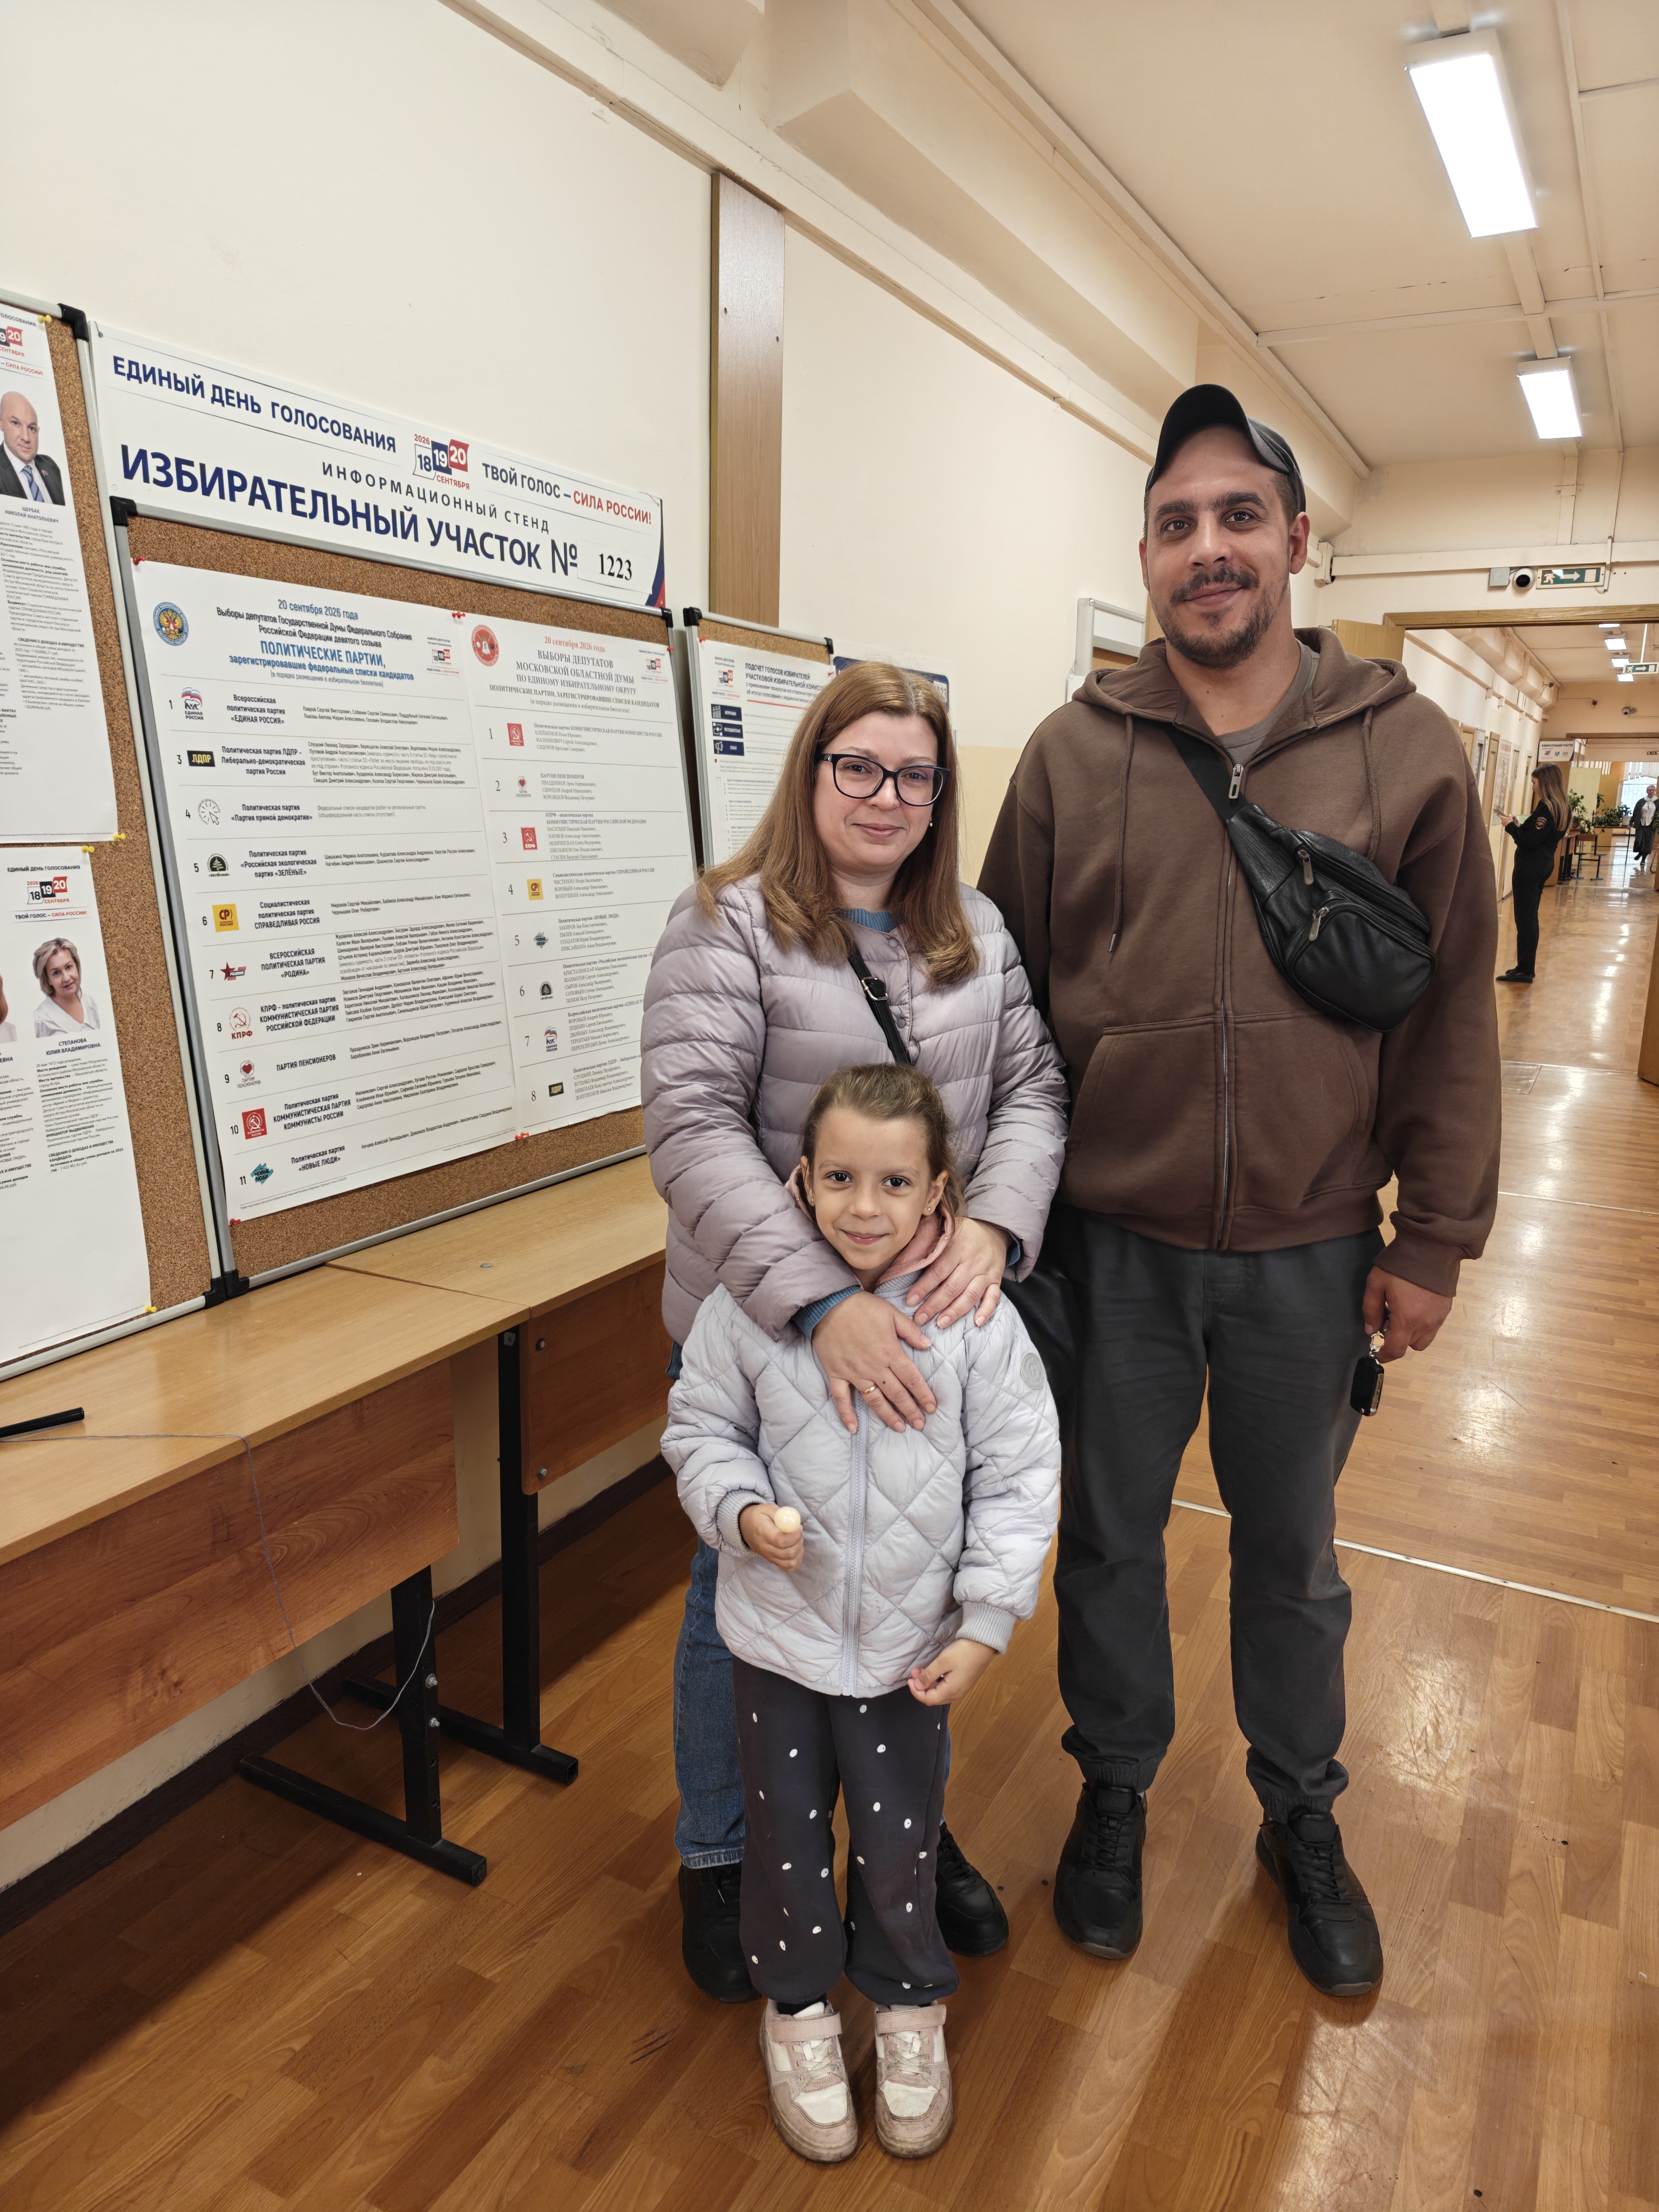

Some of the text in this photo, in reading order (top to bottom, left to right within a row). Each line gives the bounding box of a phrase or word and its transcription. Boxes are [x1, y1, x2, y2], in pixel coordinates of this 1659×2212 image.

[0, 313, 36, 327] ОЛОСОВАНИЯ
[7, 329, 21, 341] 20
[21, 366, 43, 375] РОССИИ!
[113, 355, 396, 453] ЕДИНЫЙ ДЕНЬ ГОЛОСОВАНИЯ
[414, 433, 430, 446] 2026
[417, 445, 467, 473] 18 19 20
[436, 475, 470, 490] СЕНТЯБРЯ
[322, 462, 549, 534] ИНФОРМАЦИОННЫЙ СТЕНД
[482, 462, 652, 525] ТВОЙ ГОЛОС СИЛА РОССИИ!
[5, 509, 59, 523] НИКОЛАЙ АНАТОЛЬЕВИЧ
[120, 443, 632, 581] ИЗБИРАТЕЛЬНЫЙ УЧАСТОК № 1223
[278, 599, 358, 620] 20 сентября 2026 года
[217, 606, 412, 640] Выборы депутатов Государственной Думы Федерального Собрания
[259, 625, 381, 648] Российской Федерации девятого созыва
[544, 636, 551, 644] 20
[552, 637, 578, 649] сентября
[579, 642, 592, 650] 2026
[260, 640, 386, 668] ПОЛИТИЧЕСКИЕ ПАРТИИ,
[537, 650, 613, 669] ВЫБОРЫ ДЕПУТАТОВ
[229, 655, 306, 670] зарегистрировавшие
[308, 663, 353, 675] федеральные
[355, 669, 377, 677] списки
[379, 670, 414, 680] кандидатов
[516, 660, 569, 676] МОСКОВСКОЙ
[570, 667, 613, 682] ОБЛАСТНОЙ
[615, 673, 634, 684] ДУМЫ
[745, 663, 810, 680] ПОДСЧЕТ ГОЛОСОВ ИЗБИРАТЕЛЕЙ
[516, 674, 636, 695] ПО ЕДИНОМУ ИЗБИРАТЕЛЬНОМУ ОКРУГУ
[745, 672, 806, 688] УЧАСТКОВОЙ ИЗБИРАТЕЛЬНОЙ
[233, 694, 276, 703] Всероссийская
[490, 684, 532, 694] ПОЛИТИЧЕСКИЕ
[534, 689, 556, 697] ПАРТИИ,
[557, 691, 612, 703] ЗАРЕГИСТРИРОВАВШИЕ
[631, 699, 659, 708] КАНДИДАТОВ
[169, 700, 172, 709] 1
[177, 755, 181, 764] 3
[192, 754, 211, 763] ЛДПР
[221, 757, 305, 765] Либерально-демократическая
[495, 780, 501, 791] 2
[186, 810, 191, 818] 4
[503, 833, 507, 843] 3
[194, 864, 199, 872] 5
[275, 868, 307, 876] «ЗЕЛЁНЫЕ»
[30, 880, 66, 900] 18 19 20
[508, 884, 514, 894] 4
[260, 899, 309, 908] Социалистическая
[203, 916, 207, 925] 6
[259, 911, 295, 919] политическая
[254, 917, 320, 929] СПРАВЕДЛИВАЯ РОССИЯ
[270, 948, 314, 960] ВСЕРОССИЙСКАЯ
[261, 957, 325, 970] ПОЛИТИЧЕСКАЯ ПАРТИЯ
[210, 970, 213, 979] 7
[281, 969, 309, 978] «РОДИНА»
[261, 997, 336, 1013] КПРФ политическая партия
[260, 1004, 339, 1023] КОММУНИСТИЧЕСКАЯ ПАРТИЯ
[217, 1023, 222, 1031] 8
[266, 1015, 335, 1031] РОССИЙСКОЙ ФЕДЕРАЦИИ
[231, 1030, 253, 1039] КПРФ
[58, 1038, 86, 1047] СТЕПАНОВА
[61, 1043, 100, 1053] ВЛАДИМИРОВНА
[276, 1054, 336, 1071] ПАРТИЯ ПЕНСИОНЕРОВ
[225, 1074, 229, 1083] 9
[285, 1094, 339, 1110] Политическая партия
[273, 1100, 351, 1123] КОММУНИСТИЧЕСКАЯ ПАРТИЯ
[284, 1111, 343, 1130] КОММУНИСТЫ РОССИИ
[231, 1125, 239, 1135] 10
[292, 1145, 345, 1164] Политическая партия
[299, 1156, 341, 1171] «НОВЫЕ ЛЮДИ»
[240, 1176, 246, 1185] 11
